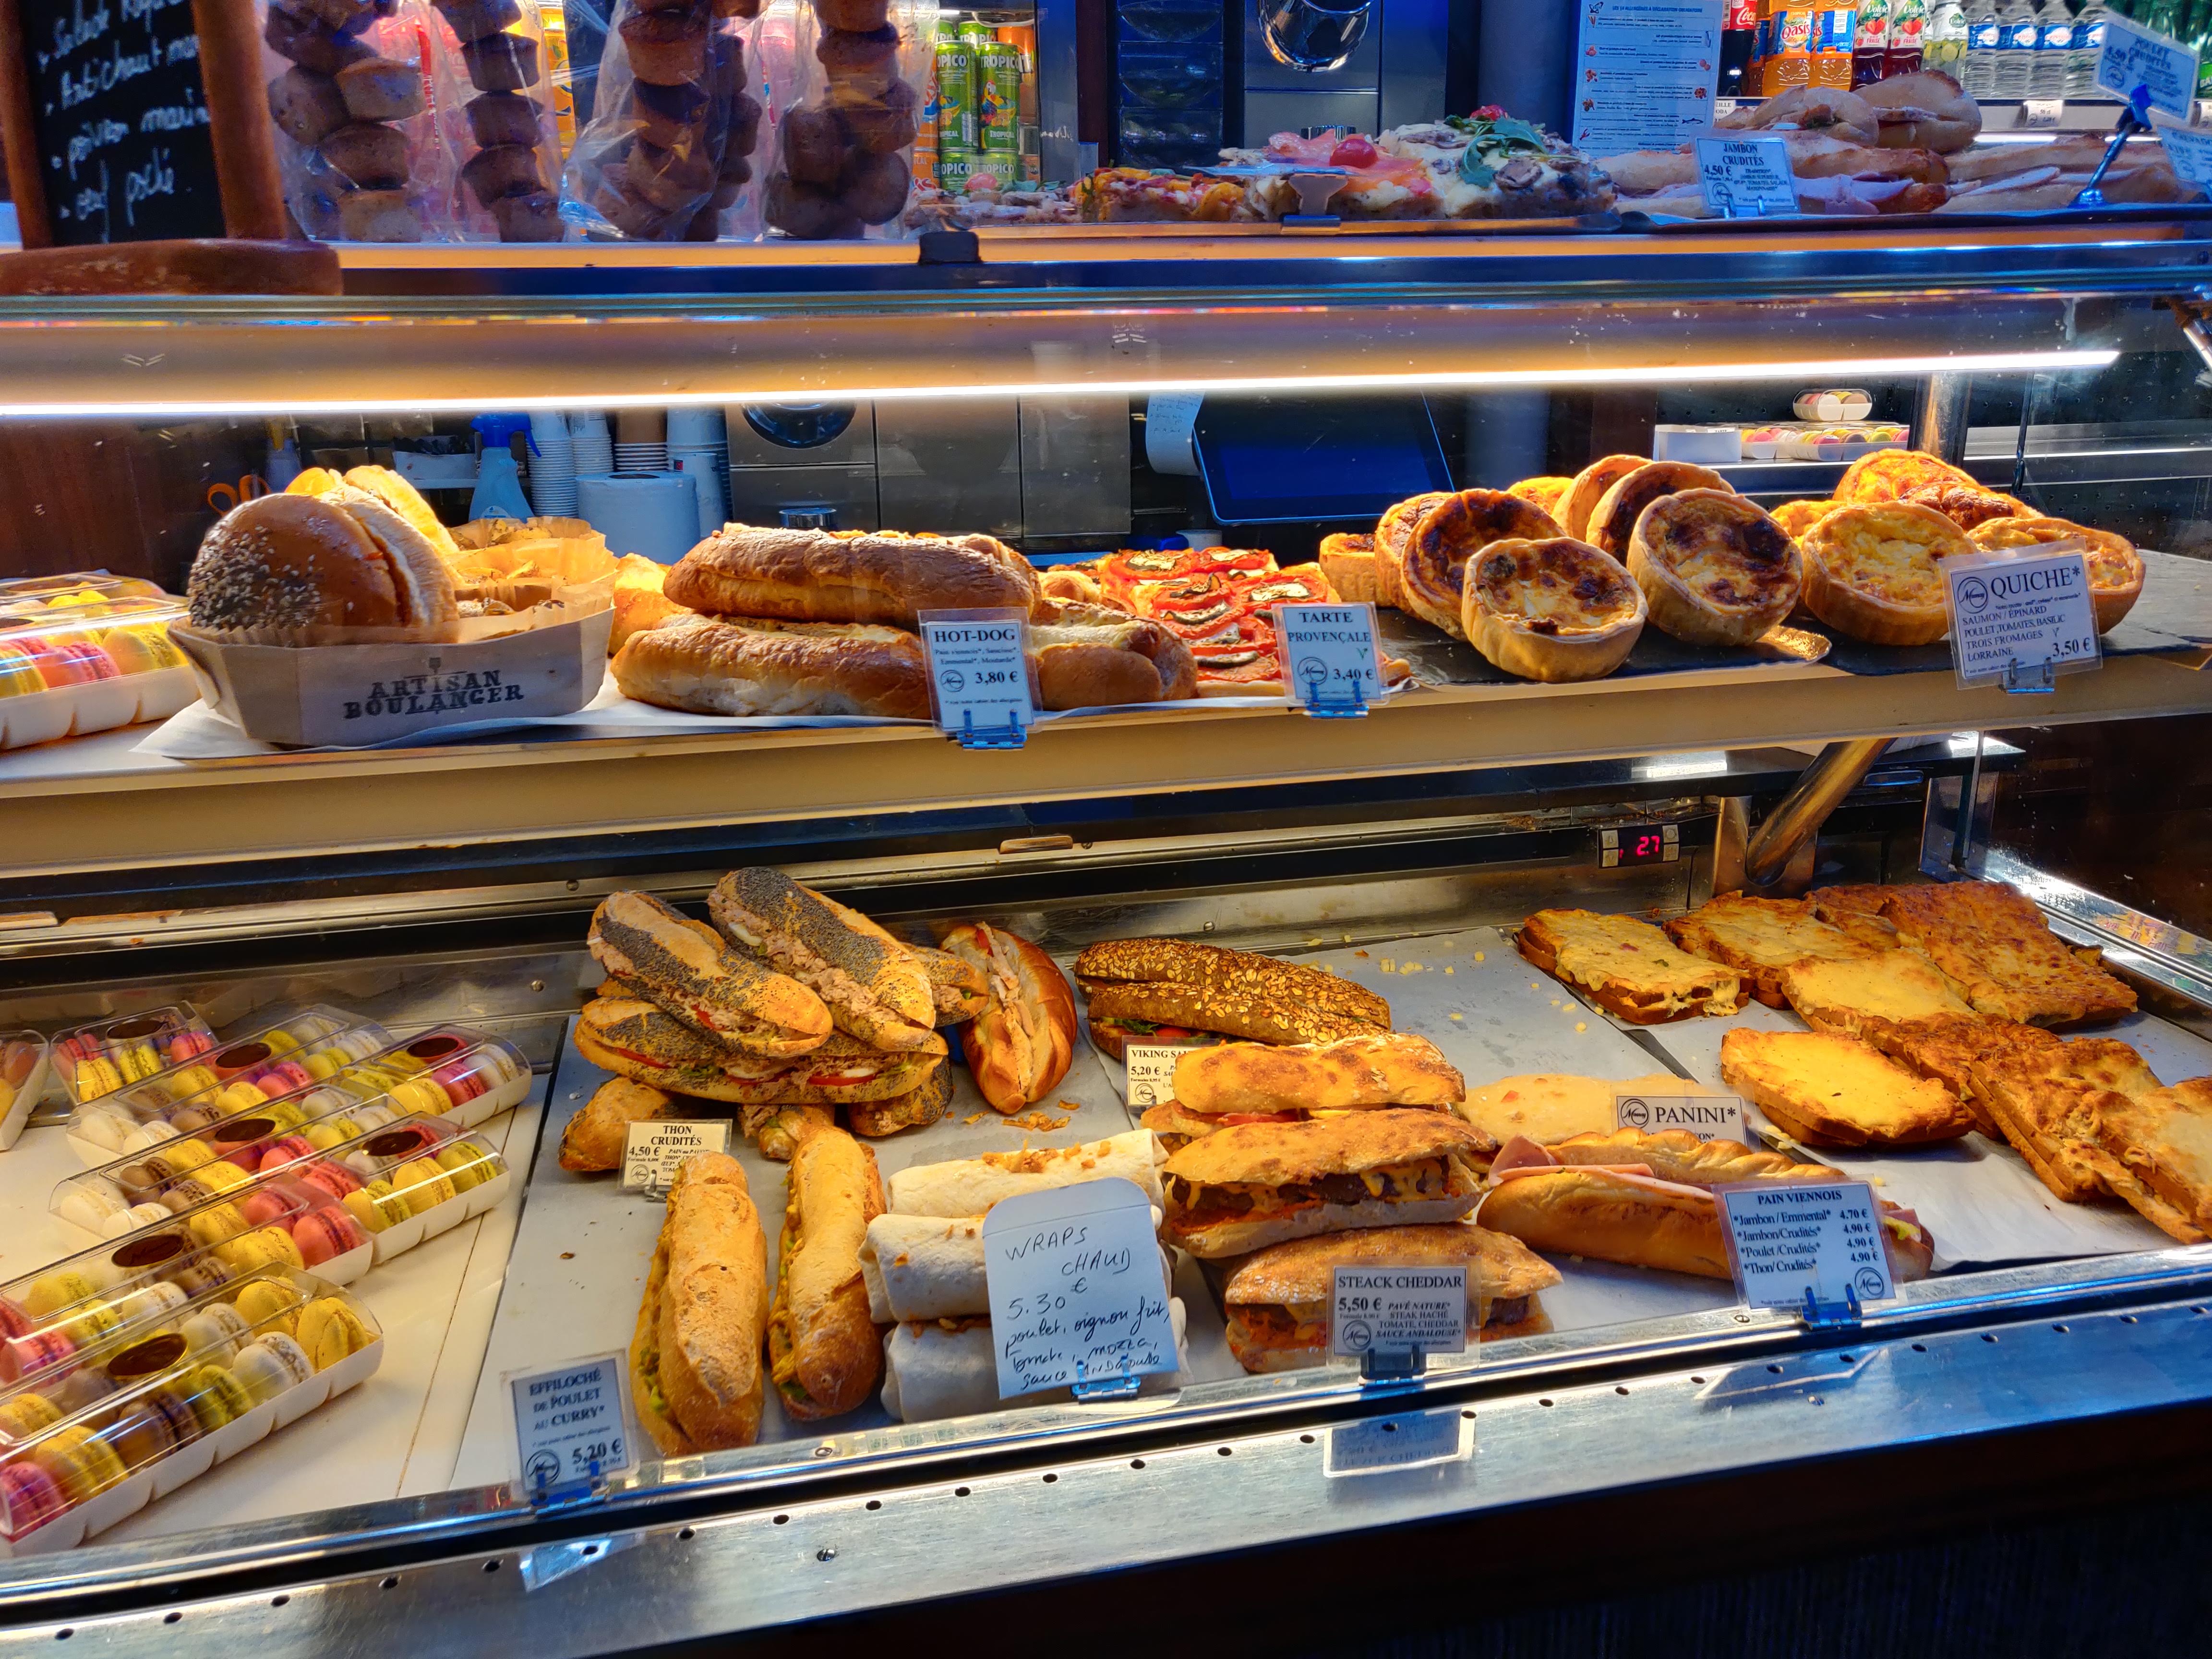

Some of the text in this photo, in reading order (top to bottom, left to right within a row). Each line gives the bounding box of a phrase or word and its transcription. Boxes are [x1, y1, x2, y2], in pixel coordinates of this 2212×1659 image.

[1867, 4, 1888, 13] Volvic
[1904, 5, 1925, 14] Volvic
[1781, 21, 1810, 40] Oasis
[1723, 143, 1758, 154] JAMBON
[1722, 155, 1765, 166] CRUDITÉS
[1704, 164, 1732, 176] 4,50 €
[1298, 612, 1353, 624] TARTE
[1962, 611, 2002, 625] SAUMON
[2008, 605, 2047, 621] ÉPINARD
[1964, 625, 1995, 638] POULET
[2036, 614, 2066, 626] BASILIC
[934, 628, 1016, 643] HOT-DOG
[1288, 632, 1371, 644] PROVENÇALE
[1965, 630, 2044, 650] TROIS FROMAGES
[1967, 647, 2014, 662] LORRAINE
[2052, 637, 2091, 659] 3,50 €
[975, 671, 1019, 686] 3,80 €
[1333, 668, 1374, 681] 3,40 €
[368, 669, 502, 699] ARTISAN
[342, 684, 525, 720] BOULANGER
[1131, 1049, 1168, 1058] VIKING
[1130, 1066, 1160, 1076] 5,20 €
[663, 1125, 693, 1134] THON
[651, 1134, 702, 1146] CRUDITÉS
[628, 1146, 661, 1157] 4,50 €
[1757, 1190, 1843, 1206] PAIN VIENNOIS
[1776, 1211, 1780, 1224] /
[1839, 1209, 1859, 1220] 4.70
[1861, 1208, 1868, 1218] €
[1843, 1223, 1863, 1234] 4.90
[1865, 1222, 1872, 1232] €
[1005, 1226, 1089, 1261] WRAPS
[1846, 1238, 1867, 1249] 4.90
[1868, 1237, 1875, 1247] €
[1061, 1247, 1131, 1276] CHAUD
[1850, 1251, 1871, 1263] 4.90
[1872, 1251, 1879, 1262] €
[1338, 1275, 1462, 1289] STEACK CHEDDAR
[1006, 1276, 1088, 1320] 5.30 €
[1338, 1296, 1382, 1313] 5,50 €
[1388, 1300, 1411, 1311] PAVÉ
[1389, 1309, 1448, 1319] STEAK HACHÉ
[1074, 1310, 1129, 1342] oignon
[1418, 1320, 1459, 1329] CHEDDAR
[1375, 1329, 1403, 1338] SAUCE
[529, 1367, 602, 1396] EFFILOCHÉ
[550, 1386, 601, 1410] POULET
[572, 1441, 608, 1465] 5,20
[611, 1437, 624, 1455] €
